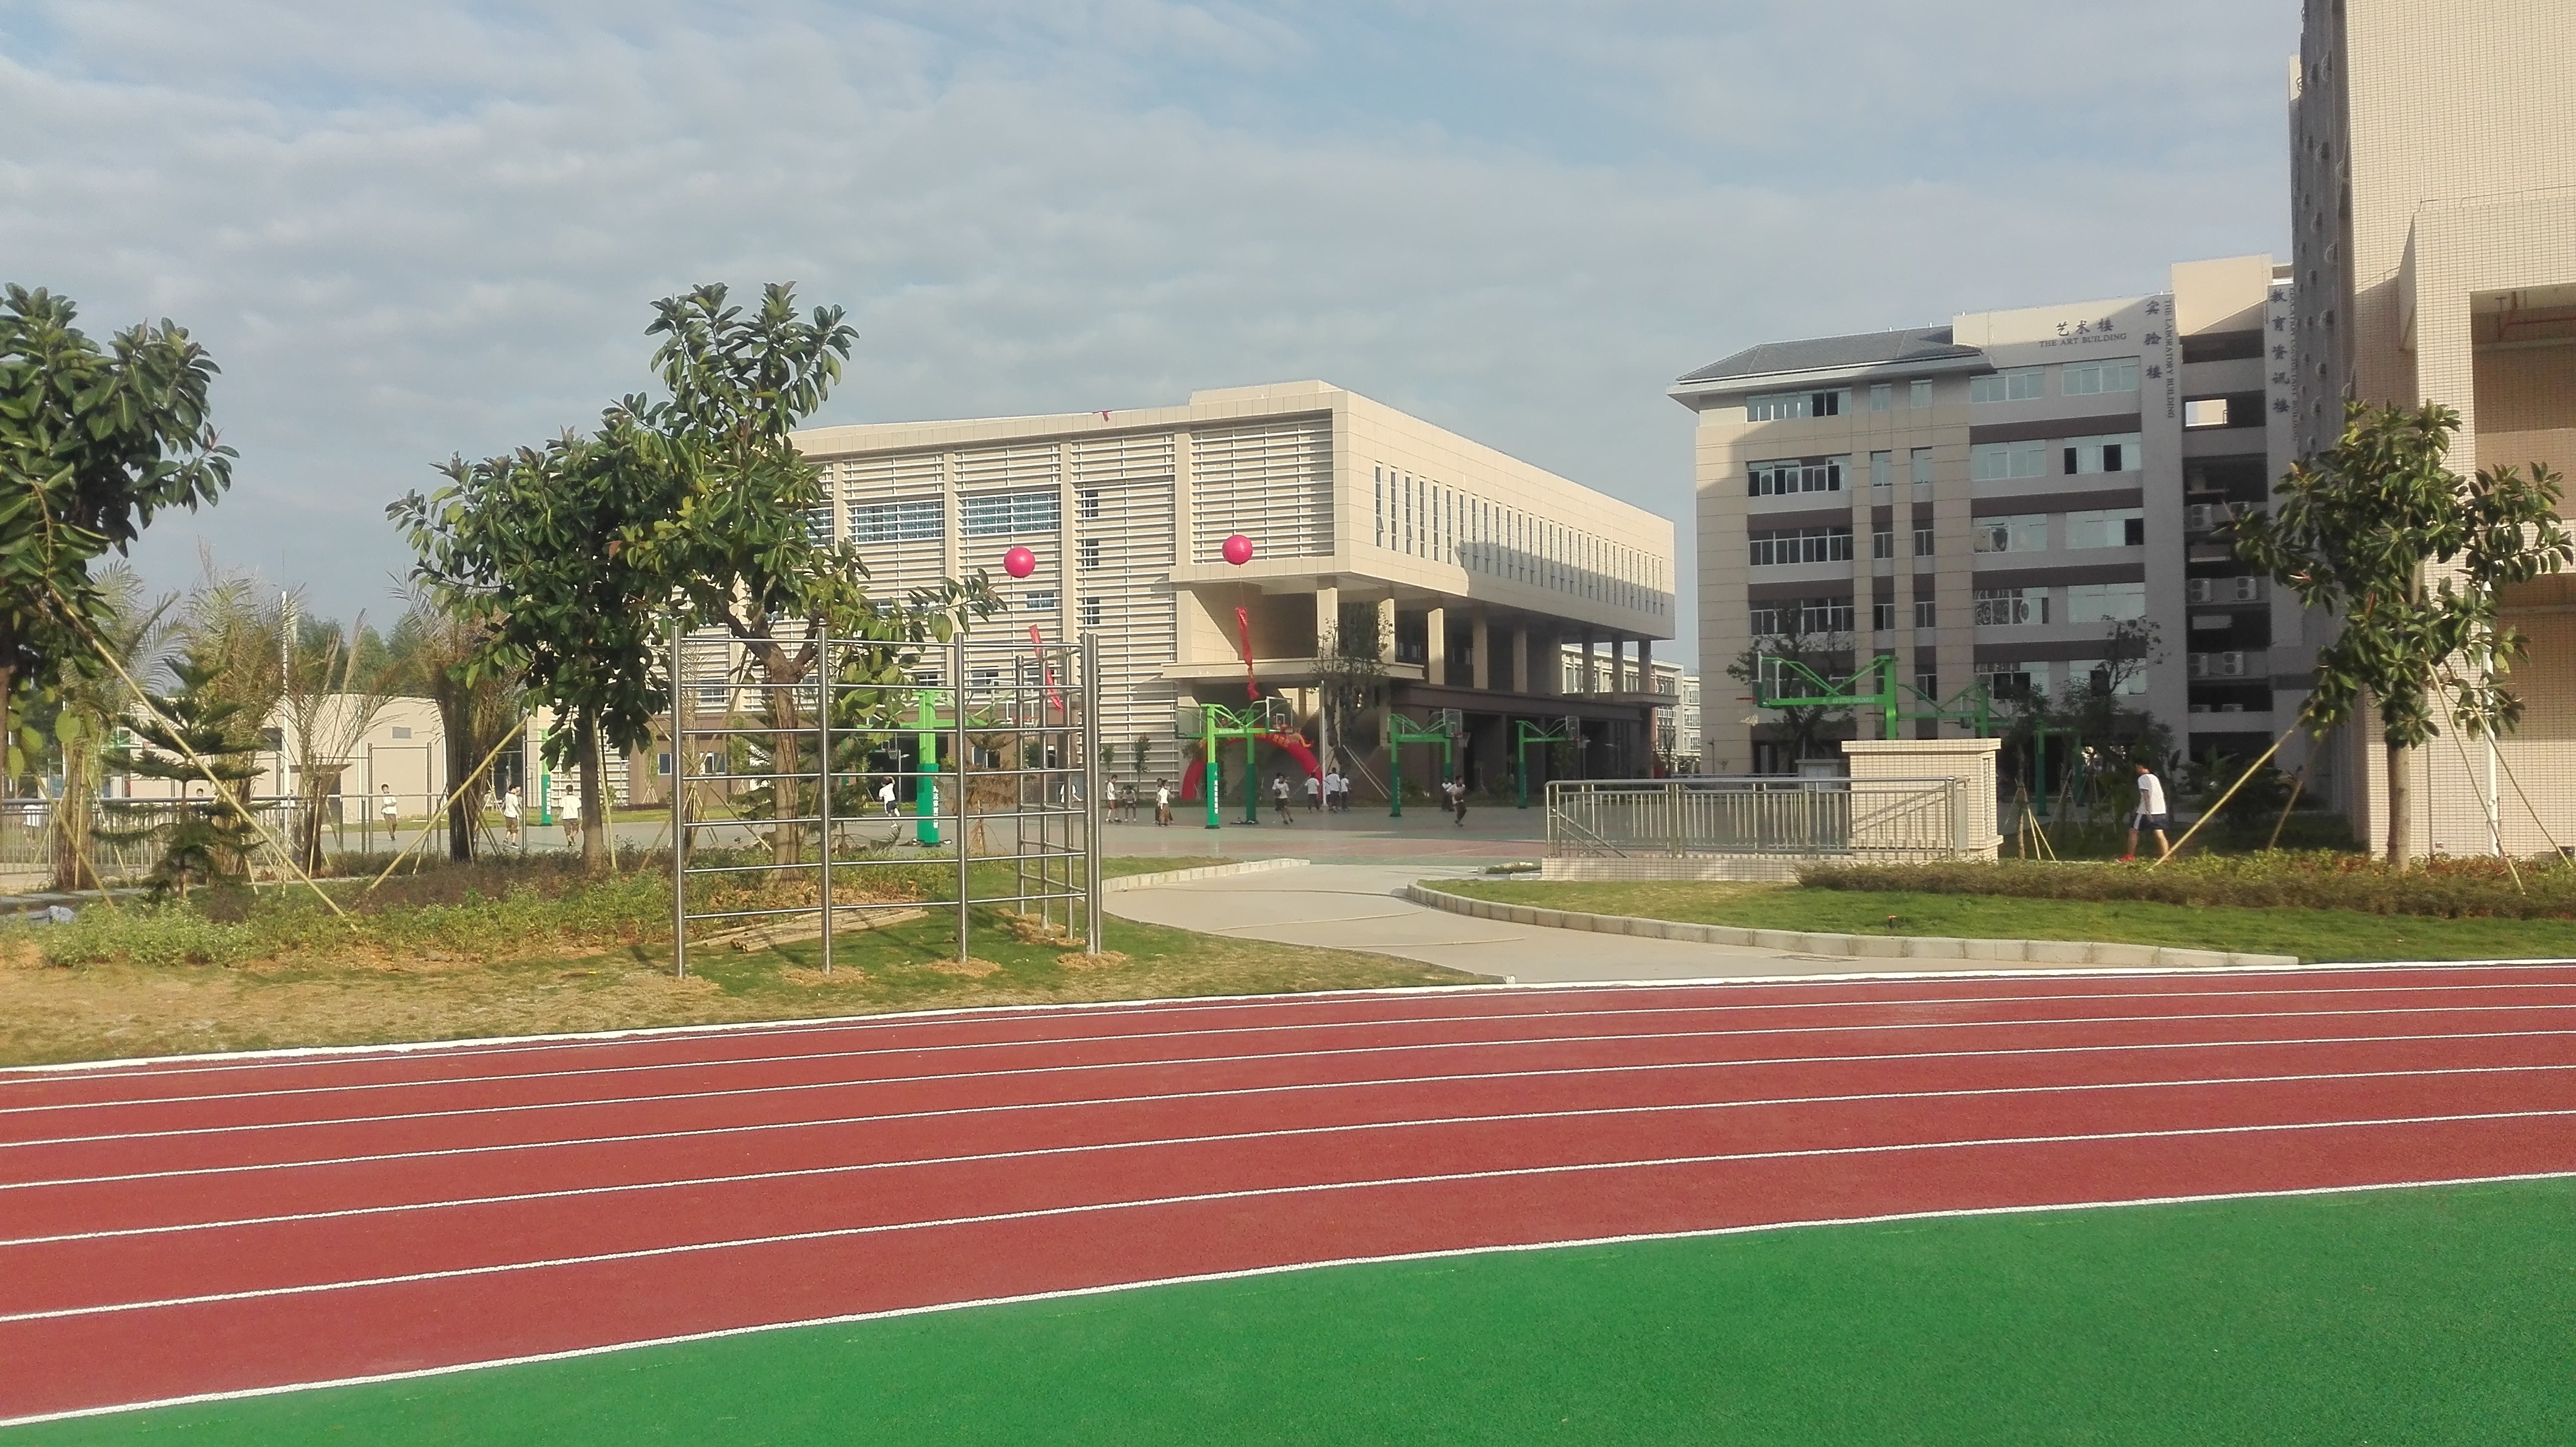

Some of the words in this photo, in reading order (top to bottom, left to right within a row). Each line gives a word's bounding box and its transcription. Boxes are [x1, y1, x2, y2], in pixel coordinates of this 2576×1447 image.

[2039, 339, 2057, 348] THE
[2061, 338, 2079, 346] ART
[2082, 333, 2128, 343] BUILDING
[2056, 317, 2114, 336] 艺术楼
[2144, 300, 2162, 379] 实验楼
[2165, 318, 2174, 374] LABORATORY
